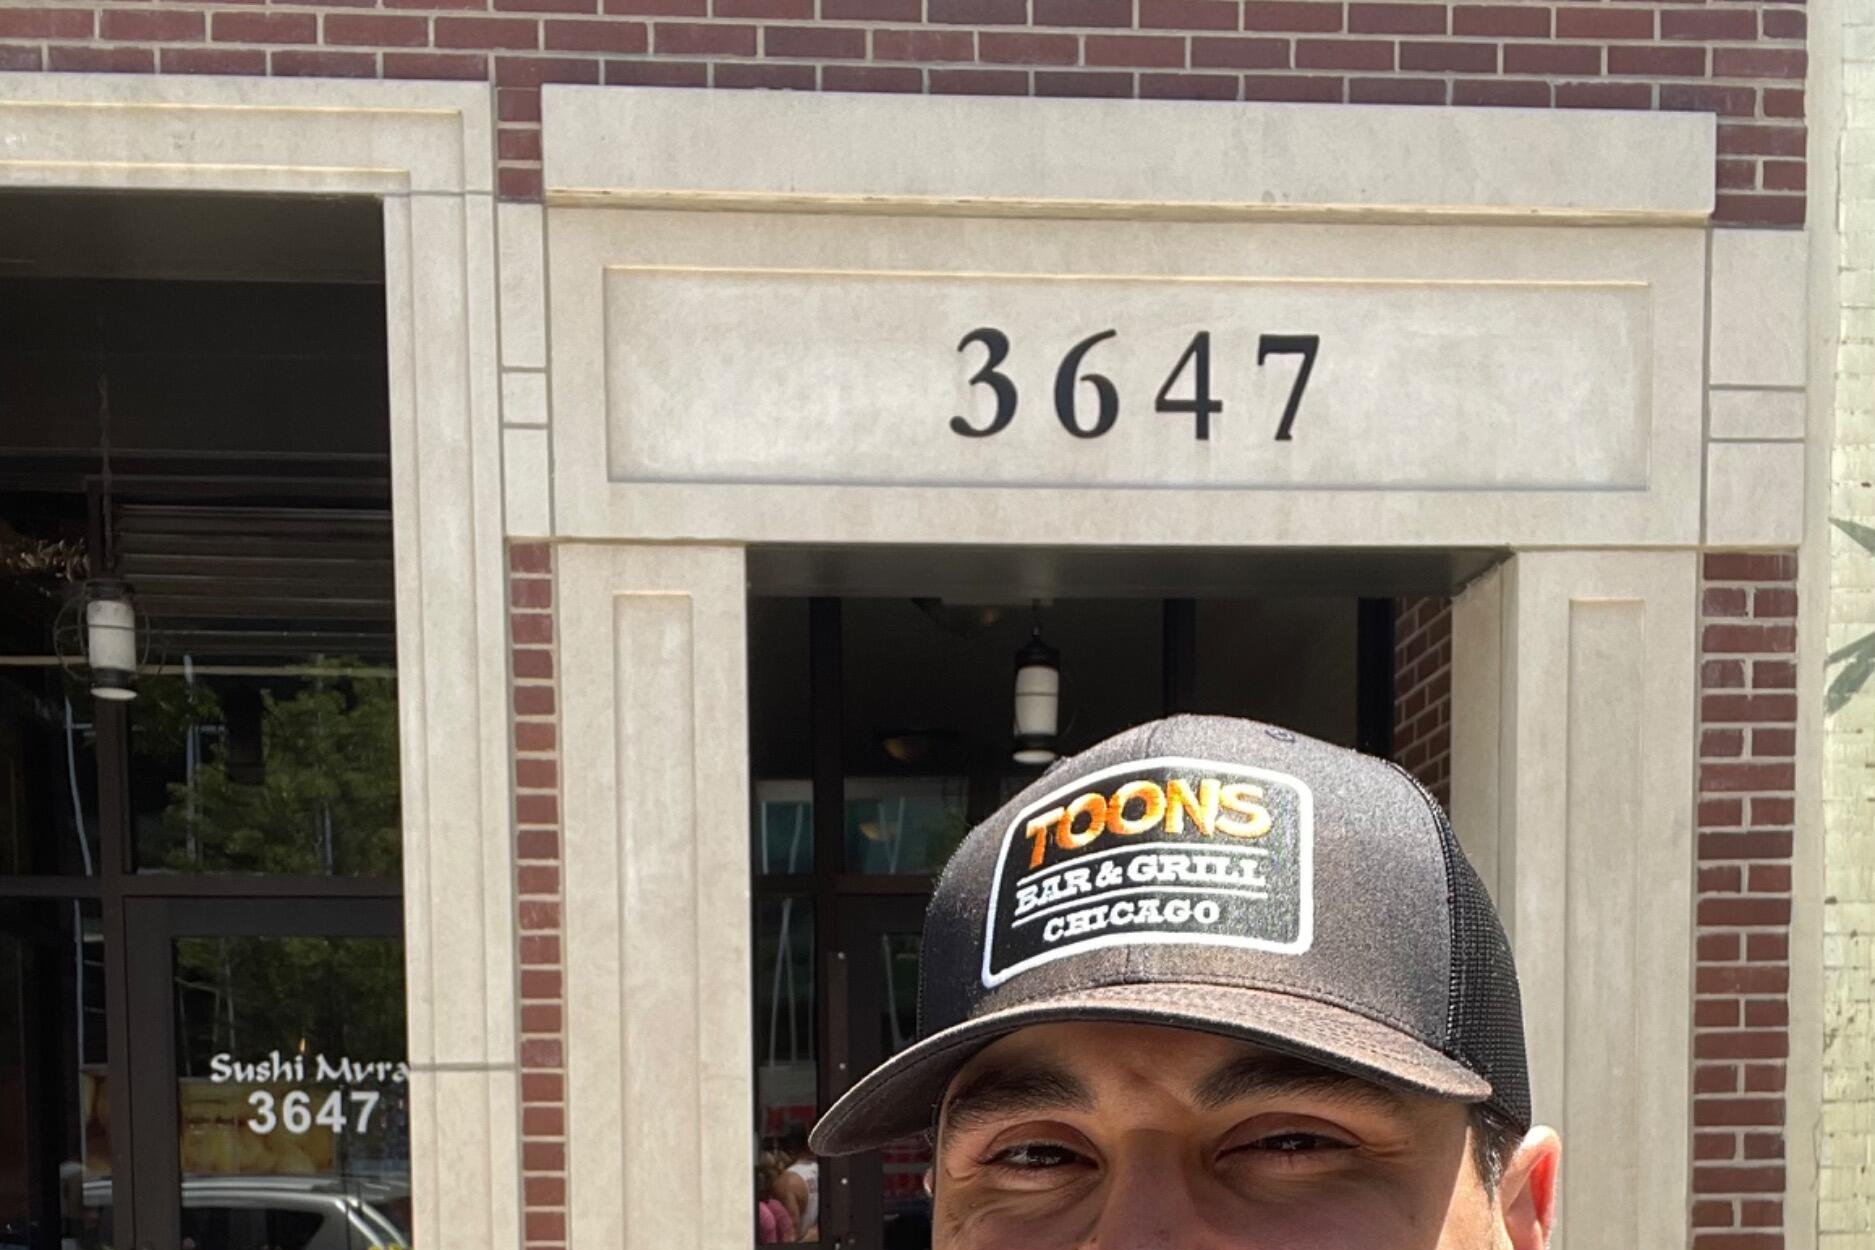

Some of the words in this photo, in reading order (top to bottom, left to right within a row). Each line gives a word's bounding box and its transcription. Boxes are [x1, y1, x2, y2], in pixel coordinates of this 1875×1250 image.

[949, 327, 1320, 441] 3647
[1026, 779, 1272, 869] TOONS
[1015, 867, 1092, 917] BAR
[1127, 855, 1268, 887] GRILL
[1043, 899, 1220, 942] CHICAGO
[210, 1050, 304, 1083] Sushi
[248, 1090, 380, 1134] 3647
